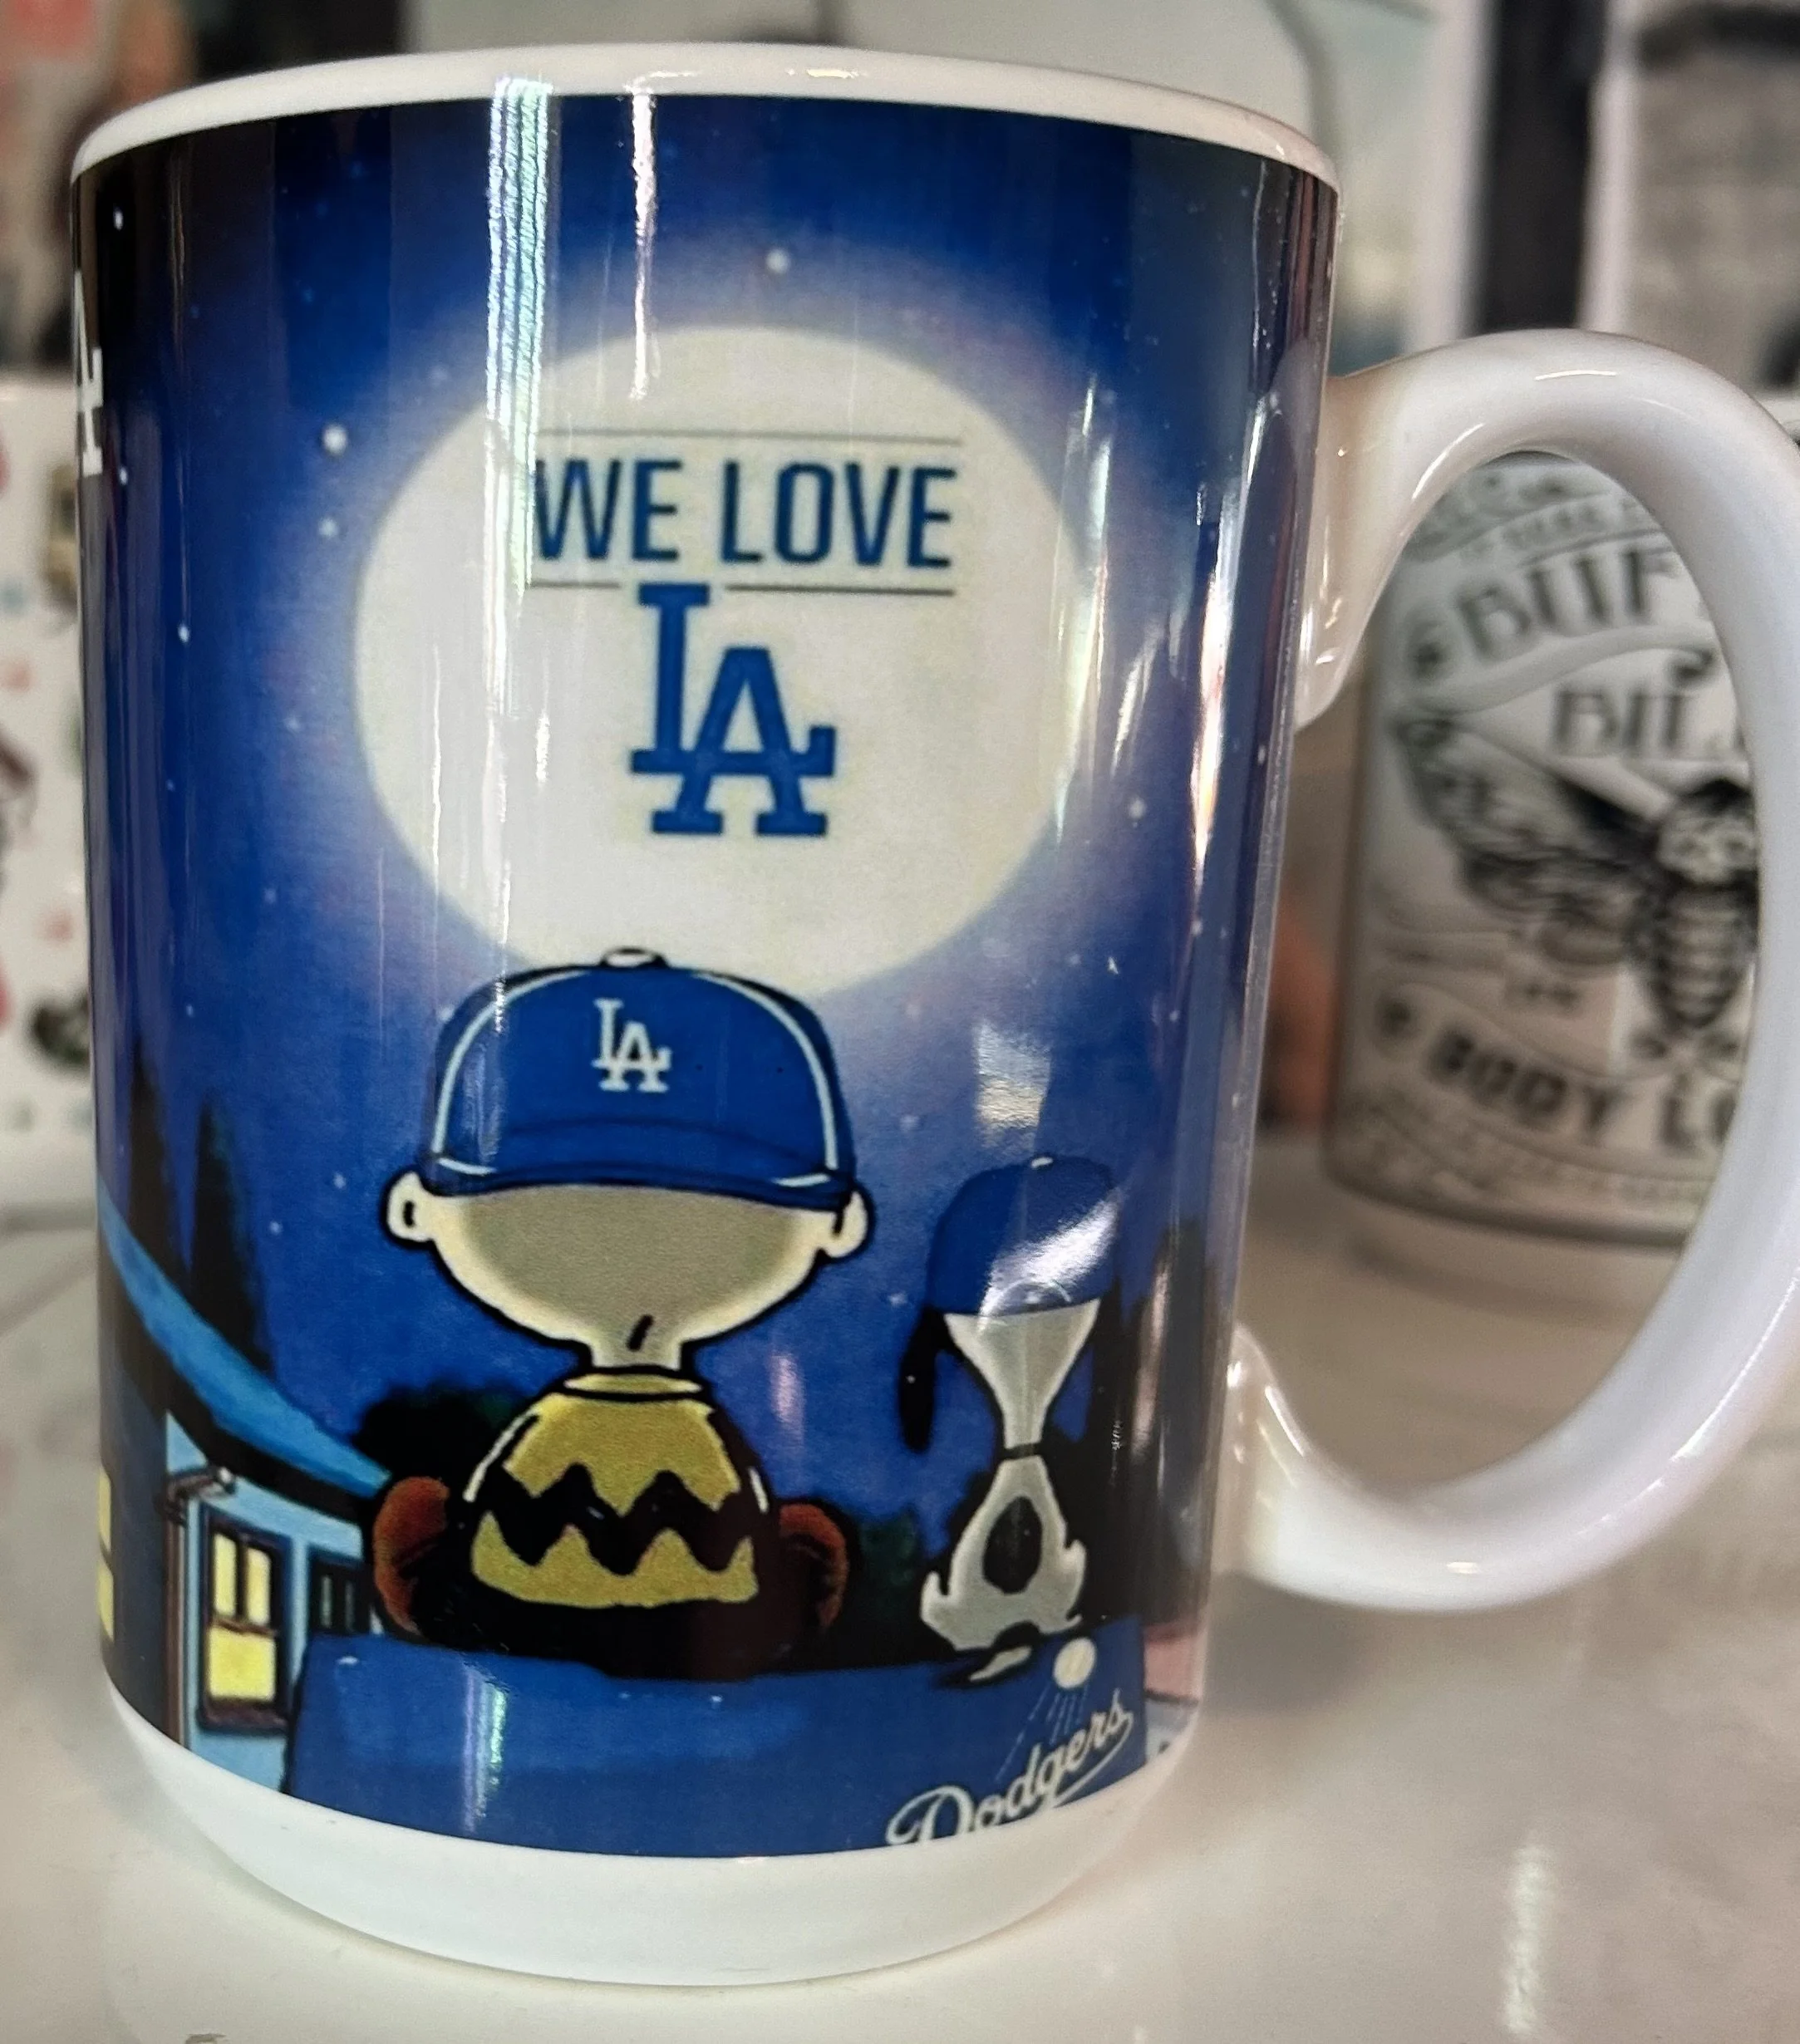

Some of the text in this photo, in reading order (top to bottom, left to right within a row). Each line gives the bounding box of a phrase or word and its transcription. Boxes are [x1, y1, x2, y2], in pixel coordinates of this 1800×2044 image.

[533, 459, 958, 569] WE LOVE
[628, 582, 838, 838] LA
[590, 997, 672, 1093] LA
[884, 1687, 1134, 1845] Dodgers
